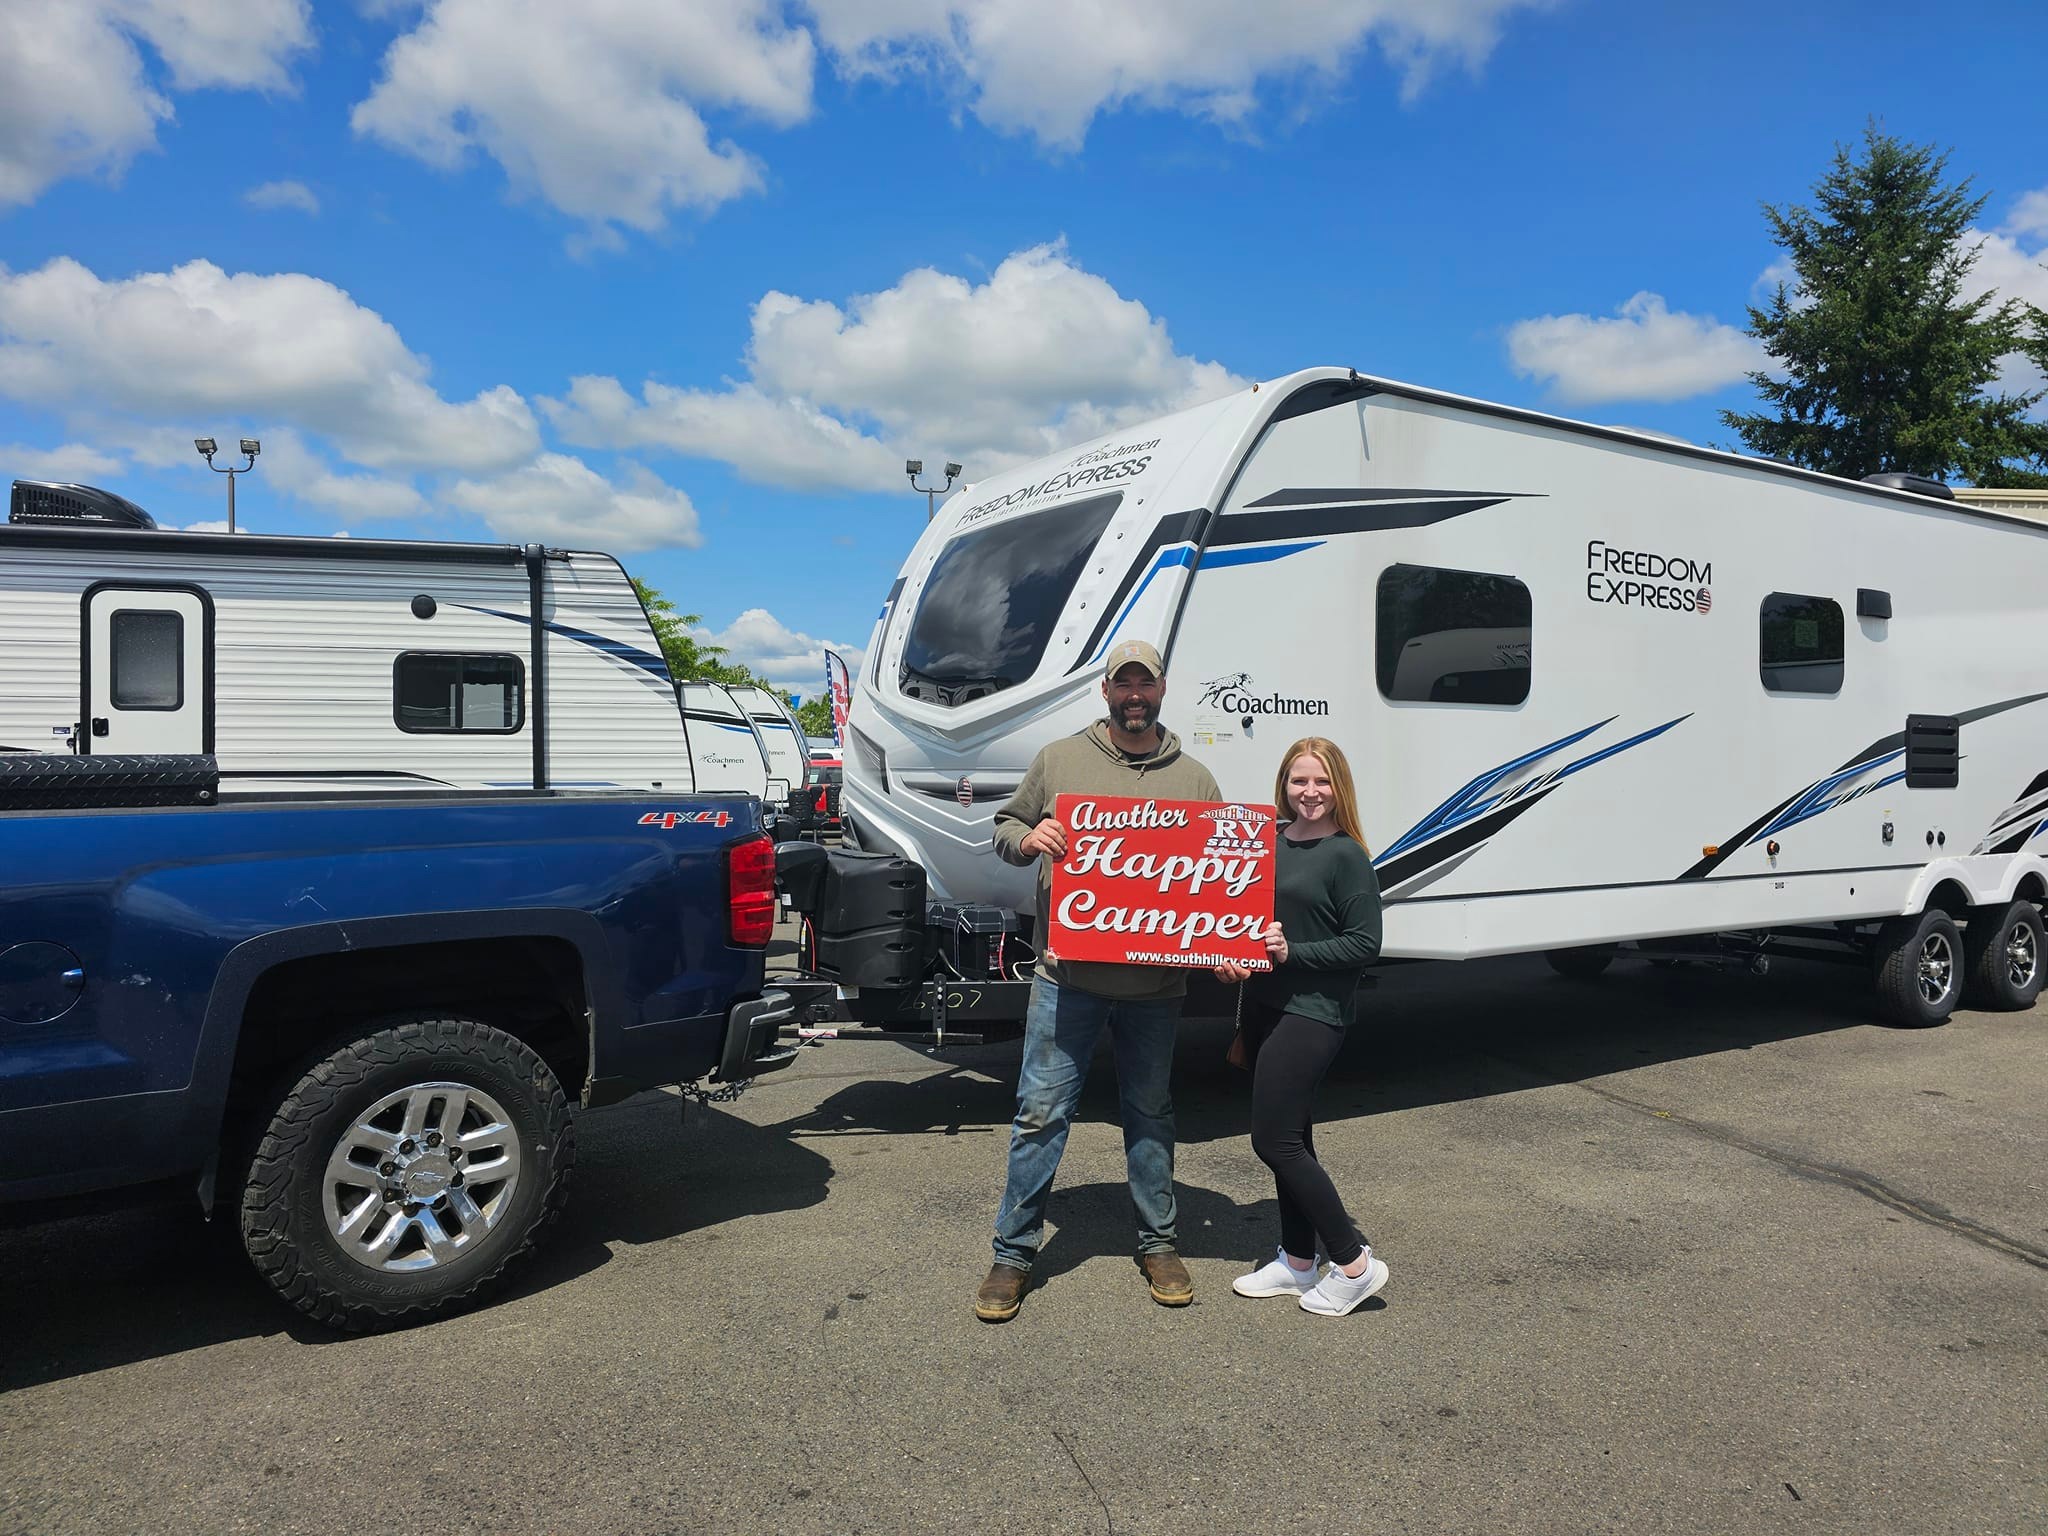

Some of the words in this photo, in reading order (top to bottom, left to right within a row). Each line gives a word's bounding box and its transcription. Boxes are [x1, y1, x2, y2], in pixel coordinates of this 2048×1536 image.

[1076, 438, 1161, 467] Coachmen
[955, 479, 1050, 528] FREEDOM
[1043, 456, 1153, 494] EXPRESS
[1587, 540, 1712, 586] FREEDOM
[1587, 572, 1696, 612] EXPRESS
[1222, 692, 1329, 716] Coachmen
[706, 756, 745, 764] Coachmen
[1070, 800, 1189, 831] Another
[1204, 808, 1237, 820] SOUTH
[1206, 838, 1265, 849] SALES
[1212, 819, 1266, 840] RV
[1064, 835, 1262, 897] Happy
[1057, 889, 1267, 950] Camper
